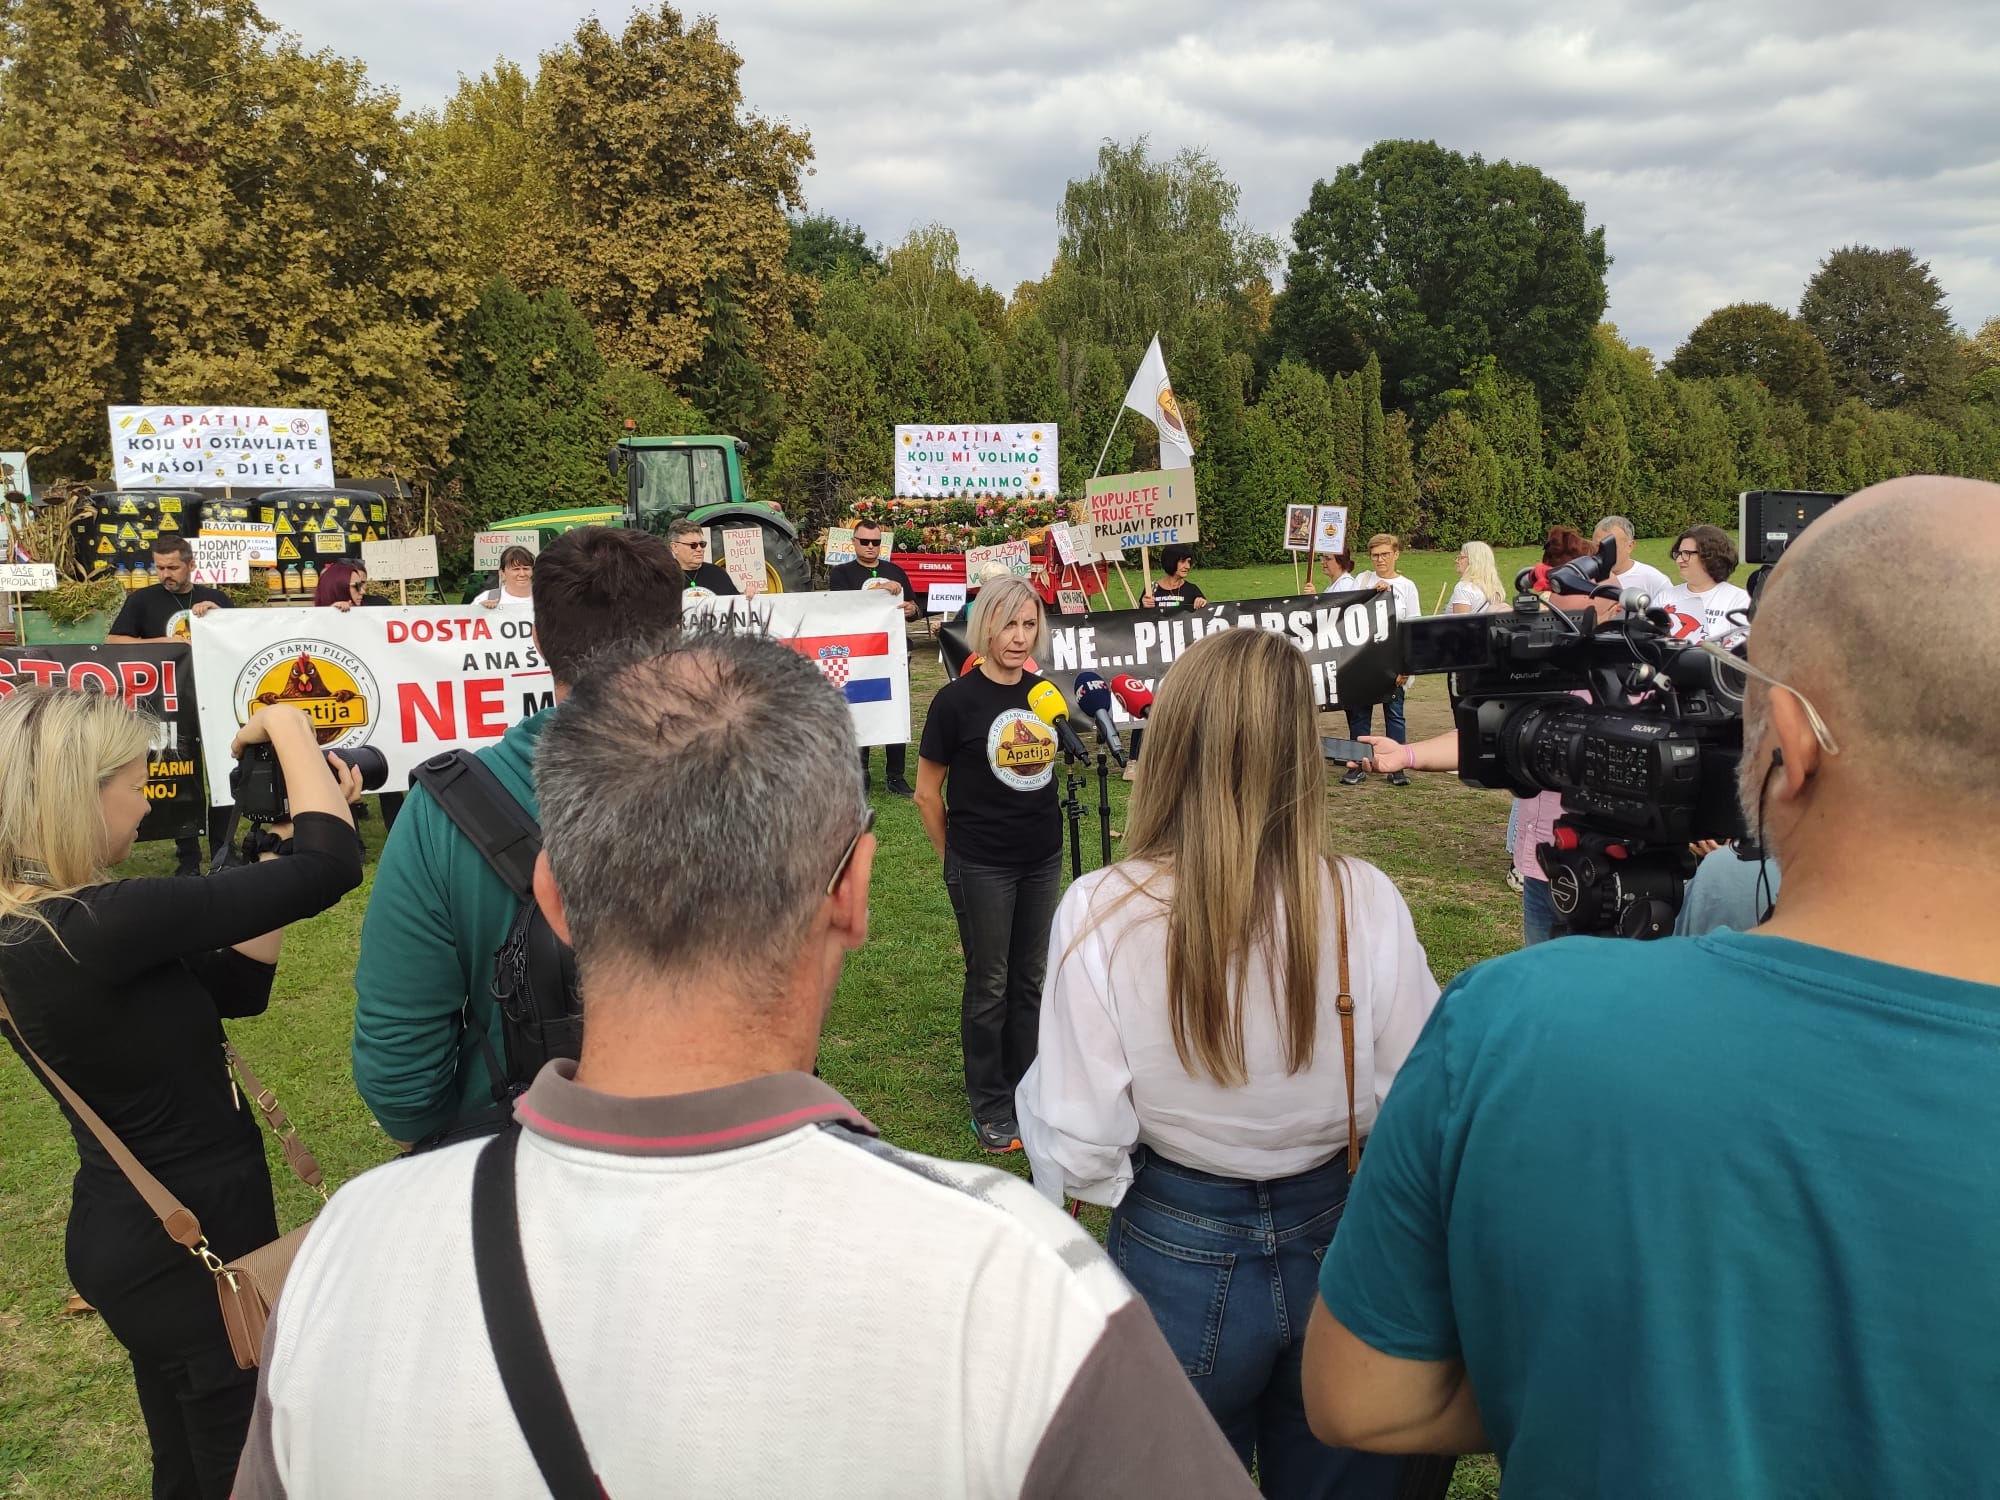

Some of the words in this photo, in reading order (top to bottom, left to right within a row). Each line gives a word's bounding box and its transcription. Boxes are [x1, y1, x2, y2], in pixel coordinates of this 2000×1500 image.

[163, 414, 269, 427] APATIJA
[926, 431, 1002, 442] APATIJA
[128, 438, 175, 450] KOJU
[182, 438, 201, 449] VI
[210, 437, 318, 450] OSTAVLJATE
[908, 452, 944, 462] KOJU
[952, 452, 970, 462] MI
[978, 452, 1038, 463] VOLIMO
[141, 458, 203, 473] NAŠOJ
[238, 463, 300, 475] DJECI
[928, 476, 931, 486] I
[941, 476, 1022, 487] BRANIMO
[1092, 486, 1160, 510] KUPUJETE
[1168, 486, 1172, 498] I
[1092, 503, 1155, 523] TRUJETE
[250, 524, 270, 532] BEZ
[1094, 519, 1144, 538] PRLJAVI
[1150, 512, 1195, 530] PROFIT
[724, 530, 760, 538] TRUJETE
[1120, 529, 1178, 548] SNUJETE
[199, 540, 246, 551] HODAMO
[193, 551, 242, 560] ZDIGNUTE
[730, 547, 756, 558] DJECU
[970, 550, 991, 562] STOP
[200, 561, 227, 569] LAVE
[480, 558, 500, 566] BUD
[10, 566, 33, 576] VAŠE
[194, 570, 204, 582] A
[1704, 608, 1724, 616] SKOJ
[386, 618, 492, 644] DOSTA
[500, 620, 533, 639] OD
[248, 652, 274, 678] STOP
[278, 644, 318, 656] FARMI
[323, 646, 360, 674] PILIĆA
[0, 658, 178, 712] STOP!
[300, 702, 350, 722] atija
[397, 678, 508, 743] NE
[1631, 724, 1661, 734] SONY
[342, 736, 360, 749] OKA
[1007, 746, 1050, 762] Apatija
[150, 760, 194, 776] FARMI
[143, 784, 177, 798] NOJ
